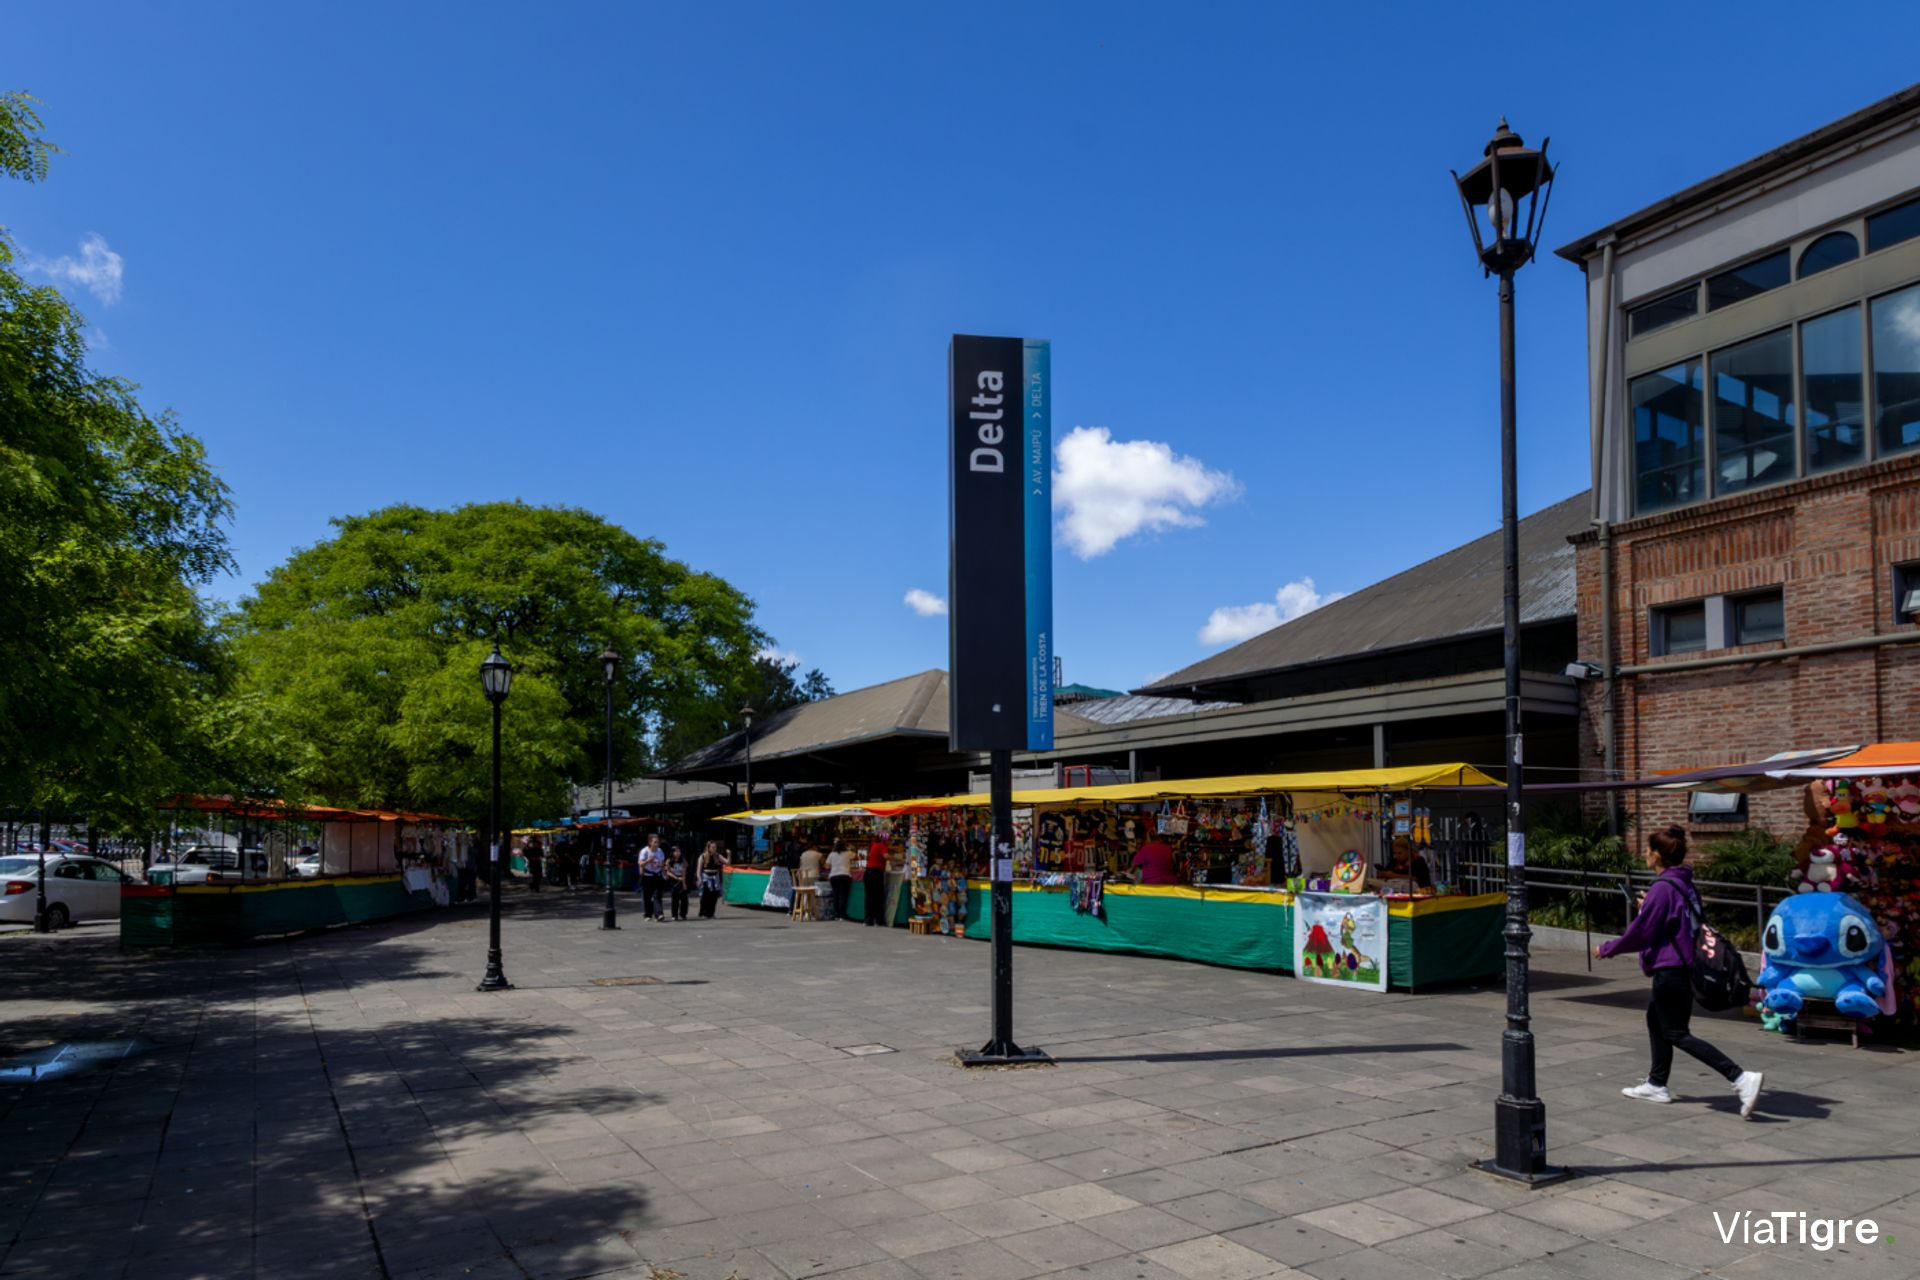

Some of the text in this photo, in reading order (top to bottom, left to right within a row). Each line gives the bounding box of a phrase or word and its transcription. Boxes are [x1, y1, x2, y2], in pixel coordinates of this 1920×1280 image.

[1031, 372, 1042, 407] DELTA
[969, 370, 1004, 473] Delta
[1031, 430, 1042, 484] AV. MAIPÚ
[1039, 632, 1047, 662] COSTA
[1039, 664, 1047, 677] LA
[1040, 679, 1047, 692] DE
